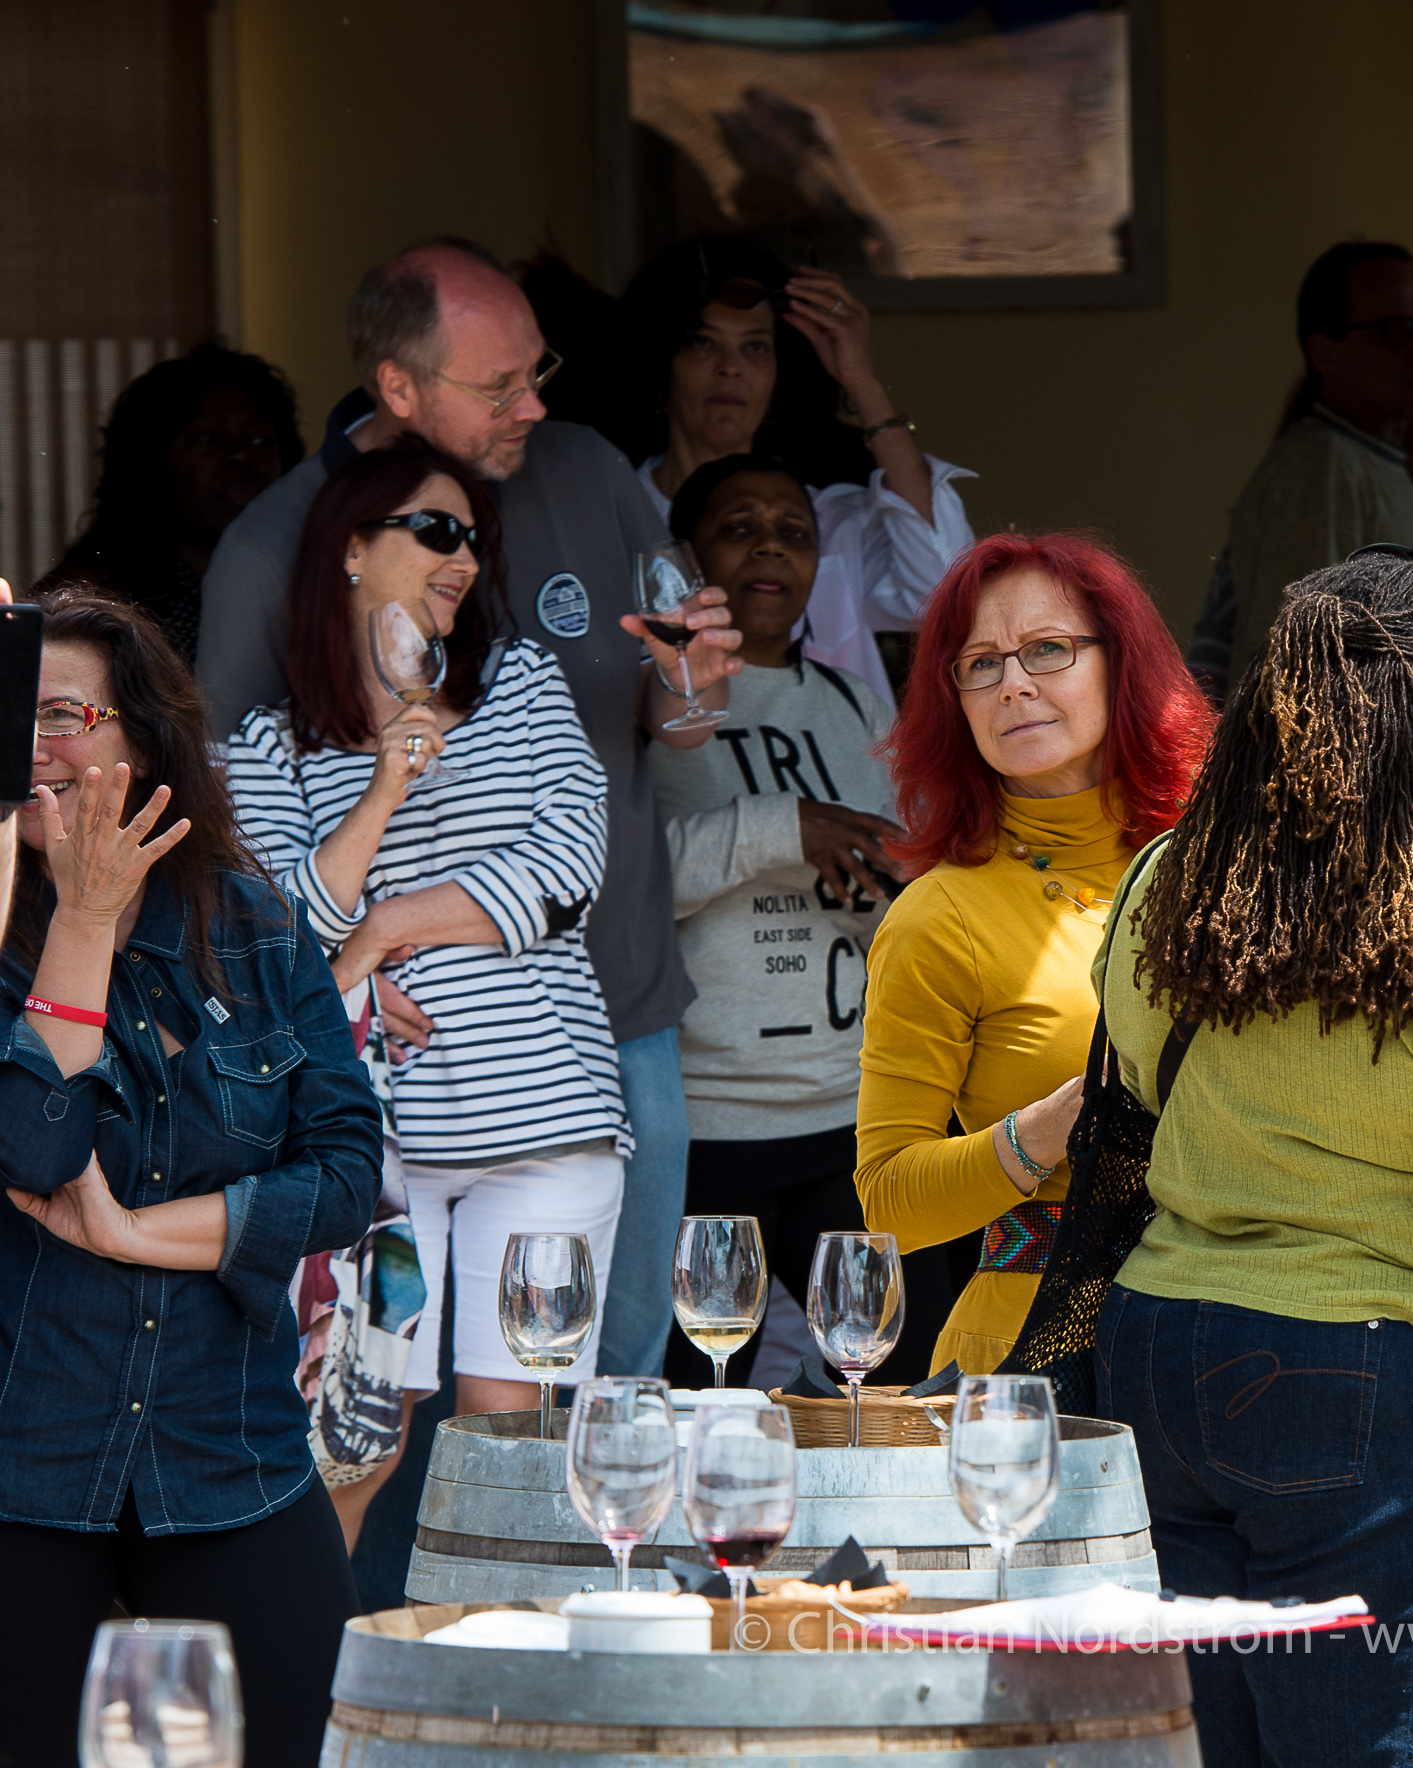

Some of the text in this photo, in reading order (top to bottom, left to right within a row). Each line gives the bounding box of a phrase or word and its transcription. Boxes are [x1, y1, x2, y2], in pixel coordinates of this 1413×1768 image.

[715, 725, 841, 802] TRI
[752, 894, 809, 915] NOLITA
[753, 926, 813, 944] EAST SIDE
[764, 954, 807, 974] SOHO
[34, 1000, 52, 1013] THE
